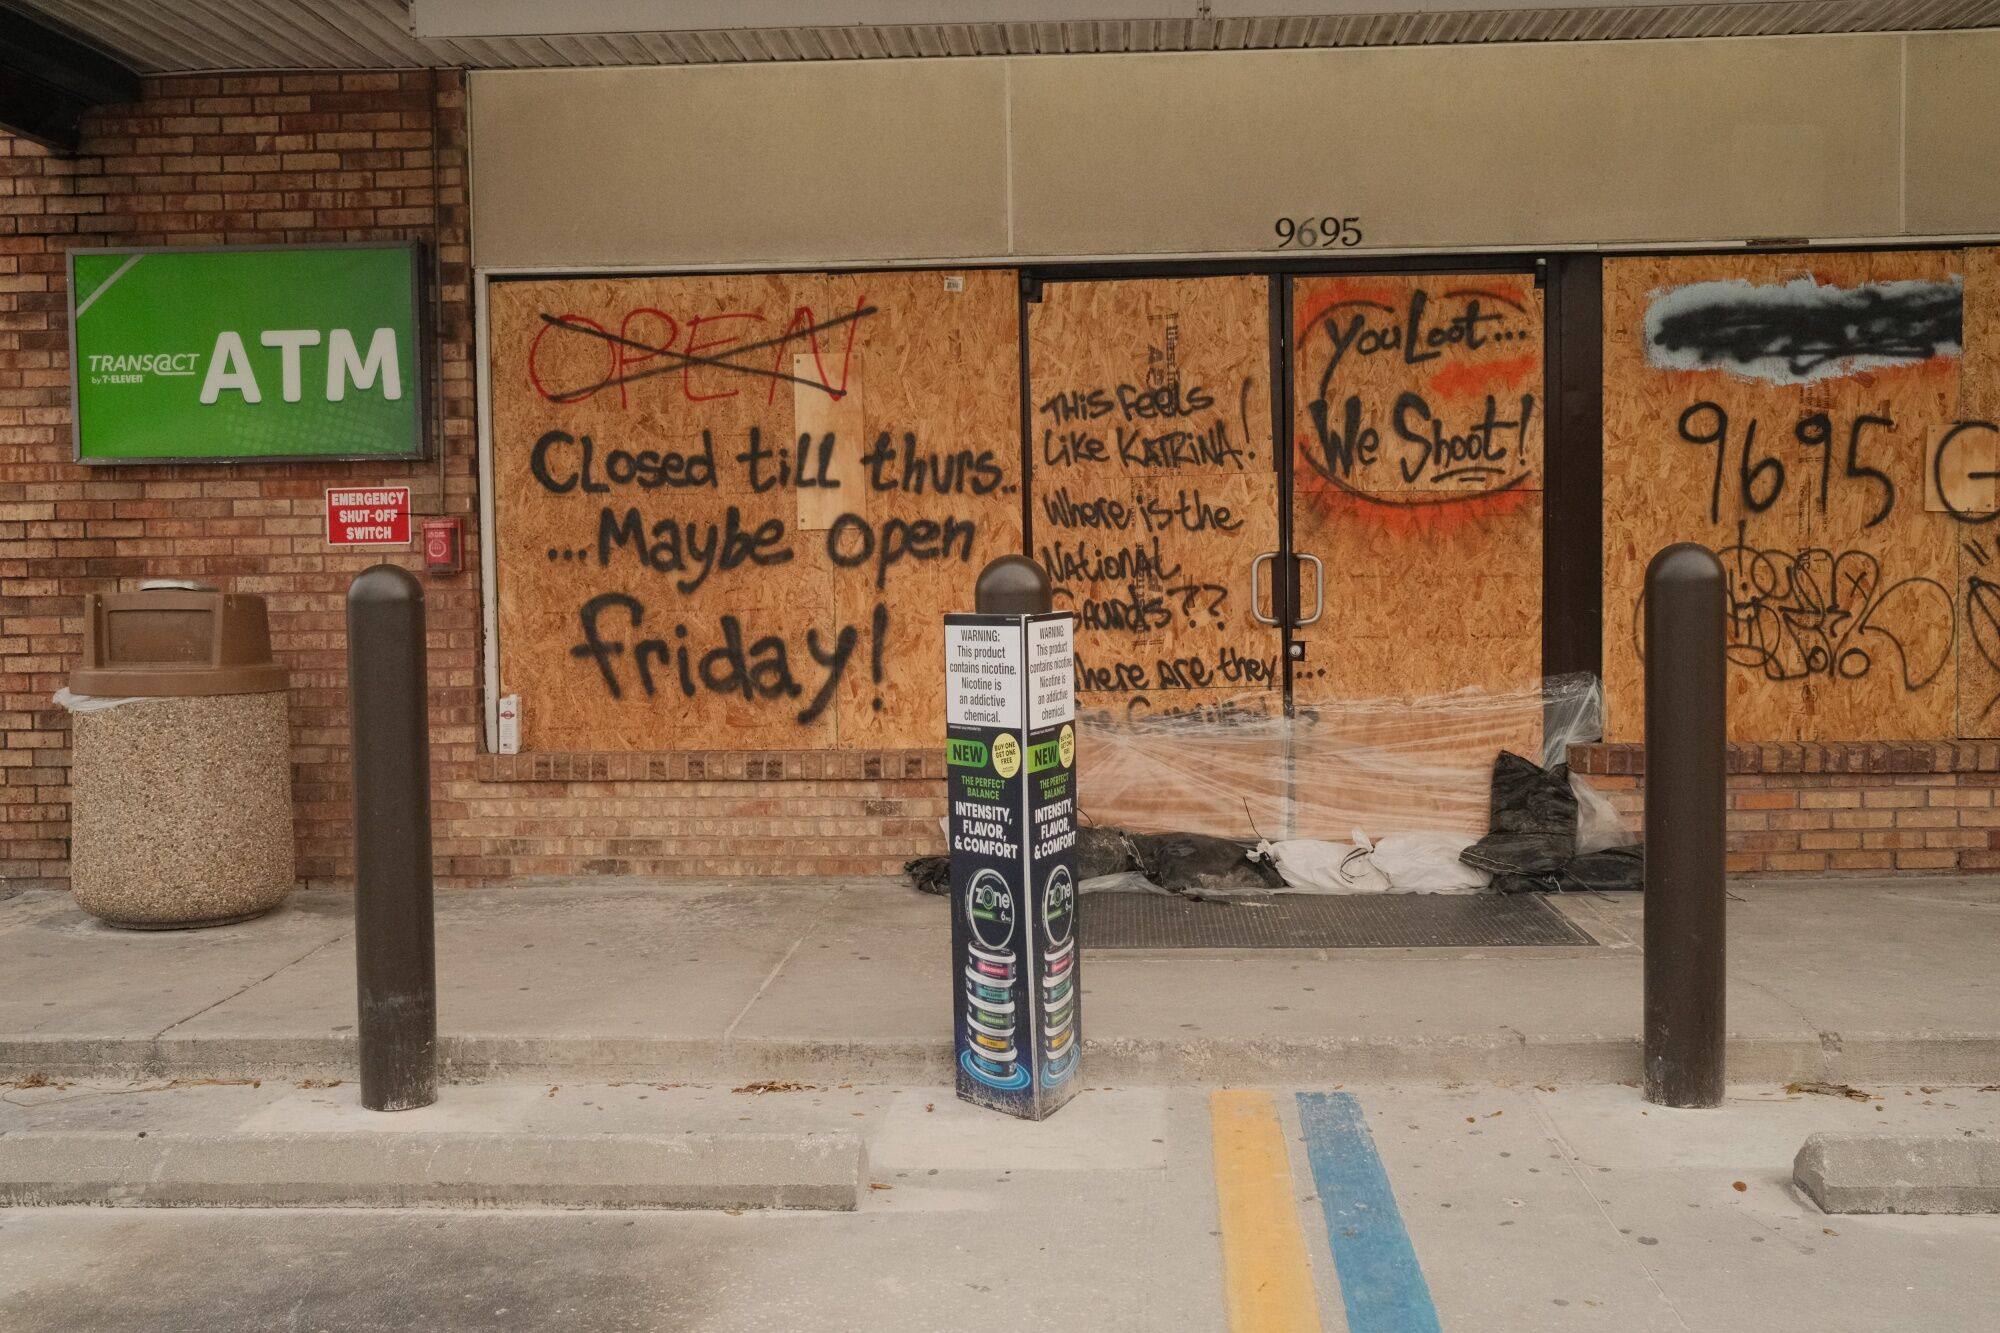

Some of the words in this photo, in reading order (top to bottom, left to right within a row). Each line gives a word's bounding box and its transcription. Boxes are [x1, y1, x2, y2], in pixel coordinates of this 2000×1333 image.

[1275, 217, 1362, 248] 9695
[1320, 313, 1401, 398] You
[1403, 289, 1526, 363] Loot...
[529, 296, 866, 408] OPEN
[89, 354, 200, 375] TRANS@CT
[200, 328, 401, 404] ATM
[92, 376, 101, 384] by
[1308, 395, 1380, 479] We
[1393, 391, 1534, 484] Shoot!
[1677, 401, 1893, 528] 9695
[331, 491, 405, 506] EMERGENCY
[339, 509, 398, 523] SHUT-OFF
[1043, 487, 1132, 530] Where
[1174, 489, 1244, 531] the
[346, 526, 392, 540] SWITCH
[961, 629, 1000, 642] WARNING:
[957, 645, 972, 658] This
[975, 646, 1006, 660] product
[1037, 644, 1048, 656] This
[1049, 641, 1068, 654] product
[949, 662, 980, 674] contains
[981, 662, 1017, 675] nicotine.
[1030, 659, 1053, 673] contains
[1075, 652, 1149, 691] here
[962, 677, 992, 690] Nicotine
[994, 679, 1002, 691] is
[1040, 676, 1060, 688] Nicotine
[1061, 674, 1066, 684] is
[959, 695, 968, 705] an
[970, 693, 1006, 707] addictive
[1038, 694, 1045, 705] an
[1046, 689, 1068, 703] addictive
[964, 709, 1001, 723] chemical.
[952, 744, 983, 763] NEW
[995, 744, 1006, 752] BUY
[1005, 741, 1016, 750] ONE
[996, 751, 1005, 759] GET
[1005, 749, 1016, 757] ONE
[1000, 757, 1013, 765] FREE
[1034, 745, 1058, 767] NEW
[962, 775, 974, 785] THE
[975, 777, 1006, 790] PERFECT
[1040, 779, 1050, 789] THE
[1050, 772, 1069, 786] PERFECT
[967, 787, 1000, 800] BALANCE
[1044, 784, 1066, 799] BALANCE
[955, 801, 1013, 826] INTENSITY,
[1034, 798, 1073, 824] INTENSITY,
[963, 819, 1007, 842] FLAVOR,
[1041, 817, 1070, 840] FLAVOR,
[954, 835, 963, 850] &
[963, 838, 1018, 859] COMFORT
[1034, 844, 1041, 860] &
[1041, 831, 1076, 856] COMFORT
